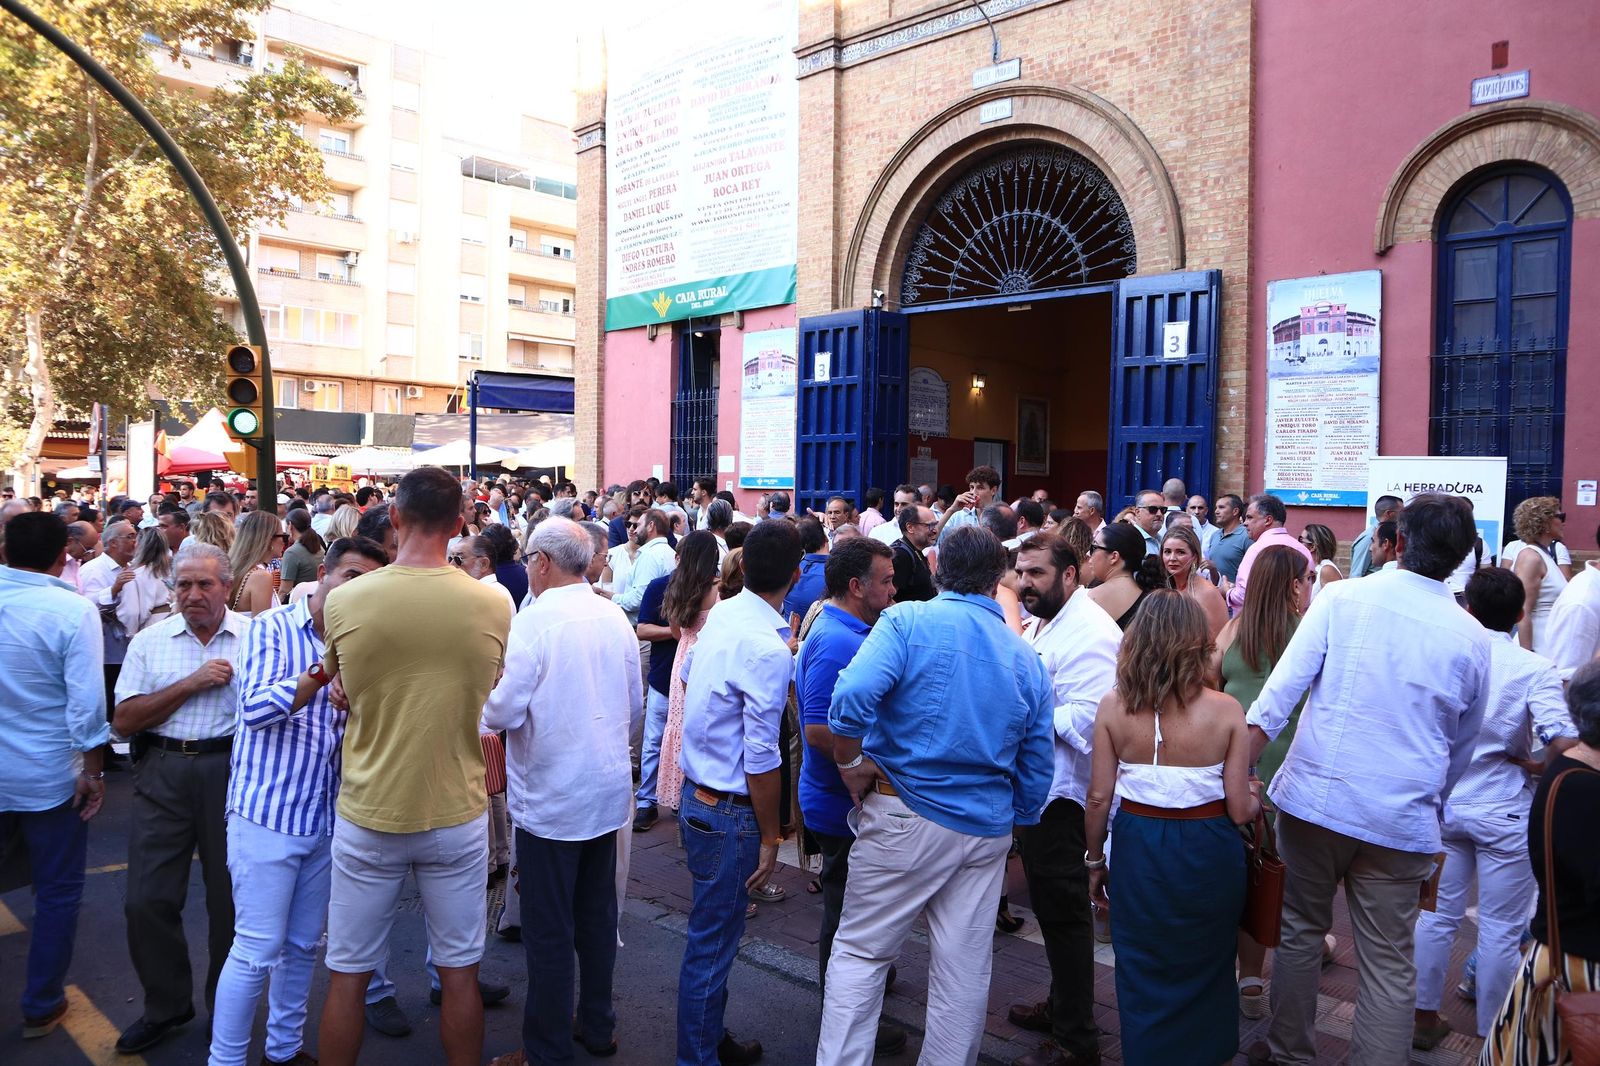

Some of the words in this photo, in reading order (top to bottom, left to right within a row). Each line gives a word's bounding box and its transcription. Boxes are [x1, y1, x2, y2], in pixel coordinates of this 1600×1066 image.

[729, 141, 785, 161] TALAVANTE
[704, 169, 728, 184] JUAN
[731, 160, 771, 177] ORTEGA
[615, 178, 644, 196] MORANTE
[649, 183, 677, 199] PERERA
[713, 184, 739, 198] ROCA
[742, 178, 761, 192] REY
[624, 207, 646, 222] DANIEL
[647, 200, 670, 215] LUQUE
[615, 225, 640, 237] DOMINGO
[656, 212, 683, 224] AGOSTO
[622, 250, 640, 263] DIEGO
[641, 242, 674, 257] VENTURA
[647, 253, 676, 268] ROMERO
[676, 292, 695, 304] CAJA
[698, 286, 728, 300] RURAL
[1170, 336, 1180, 353] 3
[819, 364, 825, 377] 3
[1387, 483, 1400, 492] LA
[1404, 482, 1483, 494] HERRADURA
